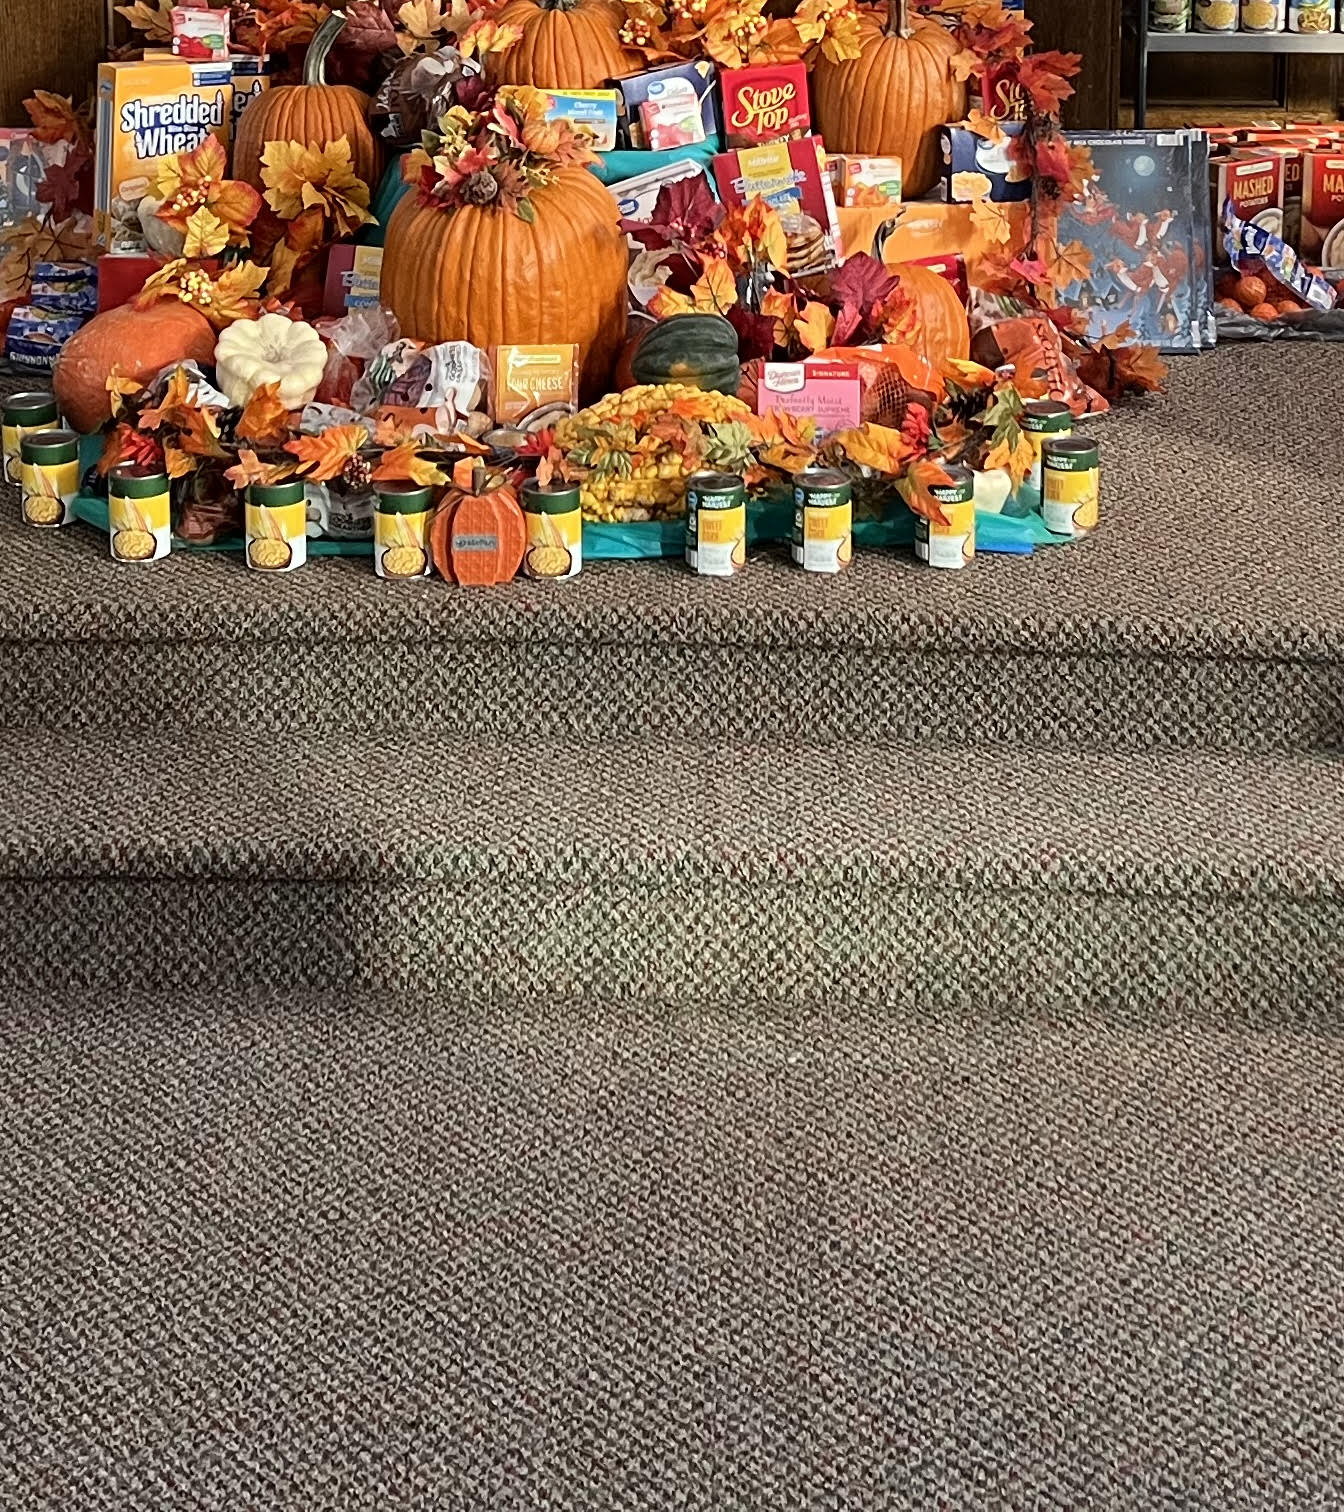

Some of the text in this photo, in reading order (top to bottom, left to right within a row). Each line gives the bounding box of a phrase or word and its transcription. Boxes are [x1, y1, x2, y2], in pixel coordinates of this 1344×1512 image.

[122, 90, 224, 131] Shredded
[731, 82, 797, 128] Stove
[757, 105, 789, 134] Top
[1233, 175, 1274, 201] MASHED
[530, 376, 564, 391] CHEESE
[818, 395, 843, 404] Moist
